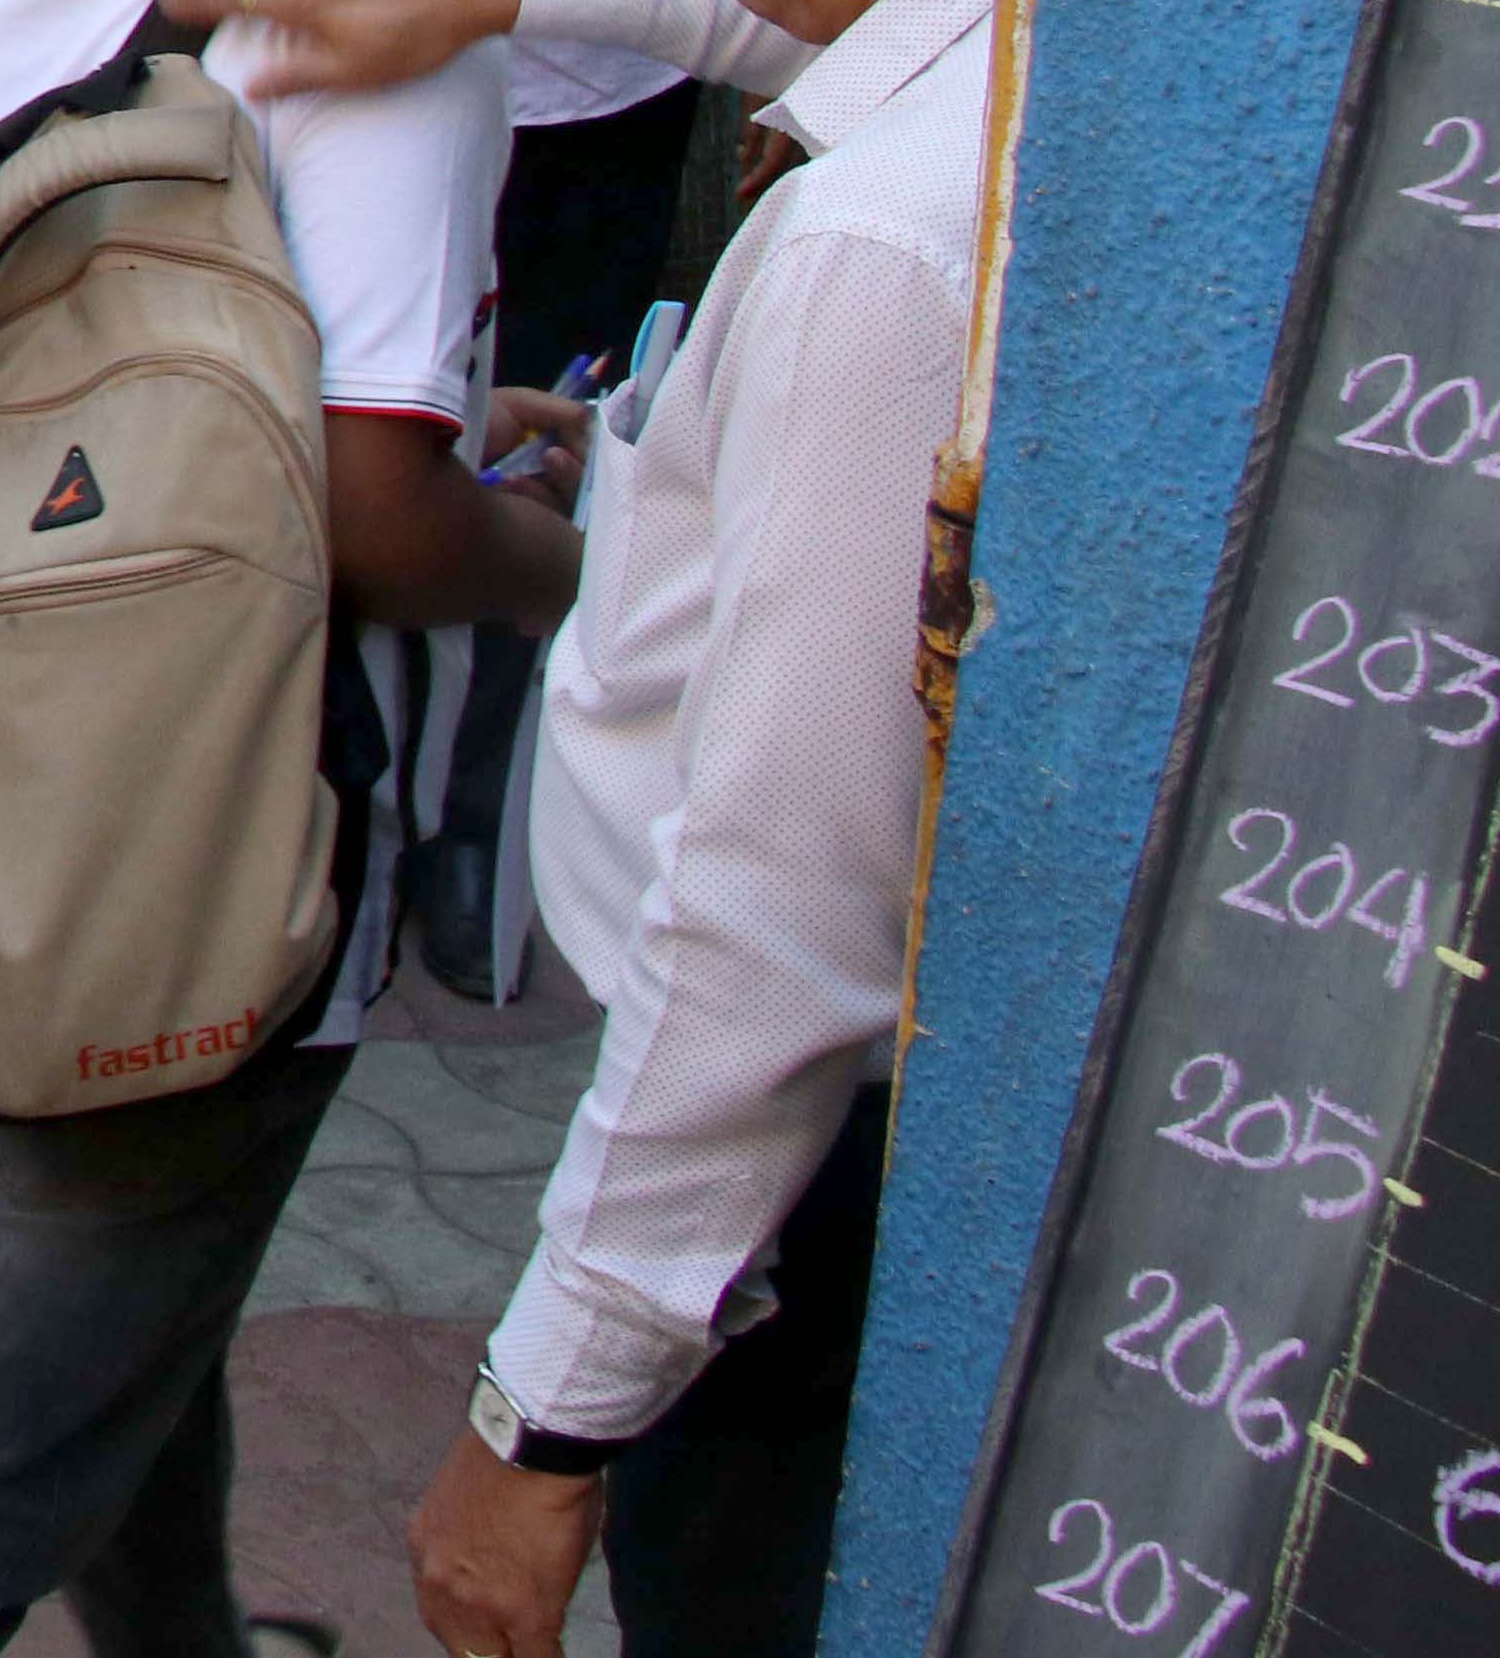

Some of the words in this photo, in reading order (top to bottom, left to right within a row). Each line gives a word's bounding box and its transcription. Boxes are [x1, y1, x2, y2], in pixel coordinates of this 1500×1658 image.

[1399, 114, 1500, 230] 2
[1272, 595, 1500, 747] 203
[1219, 807, 1430, 990] 204
[1155, 1052, 1382, 1222] 205
[1103, 1268, 1306, 1463] 206
[1033, 1499, 1253, 1658] 207
